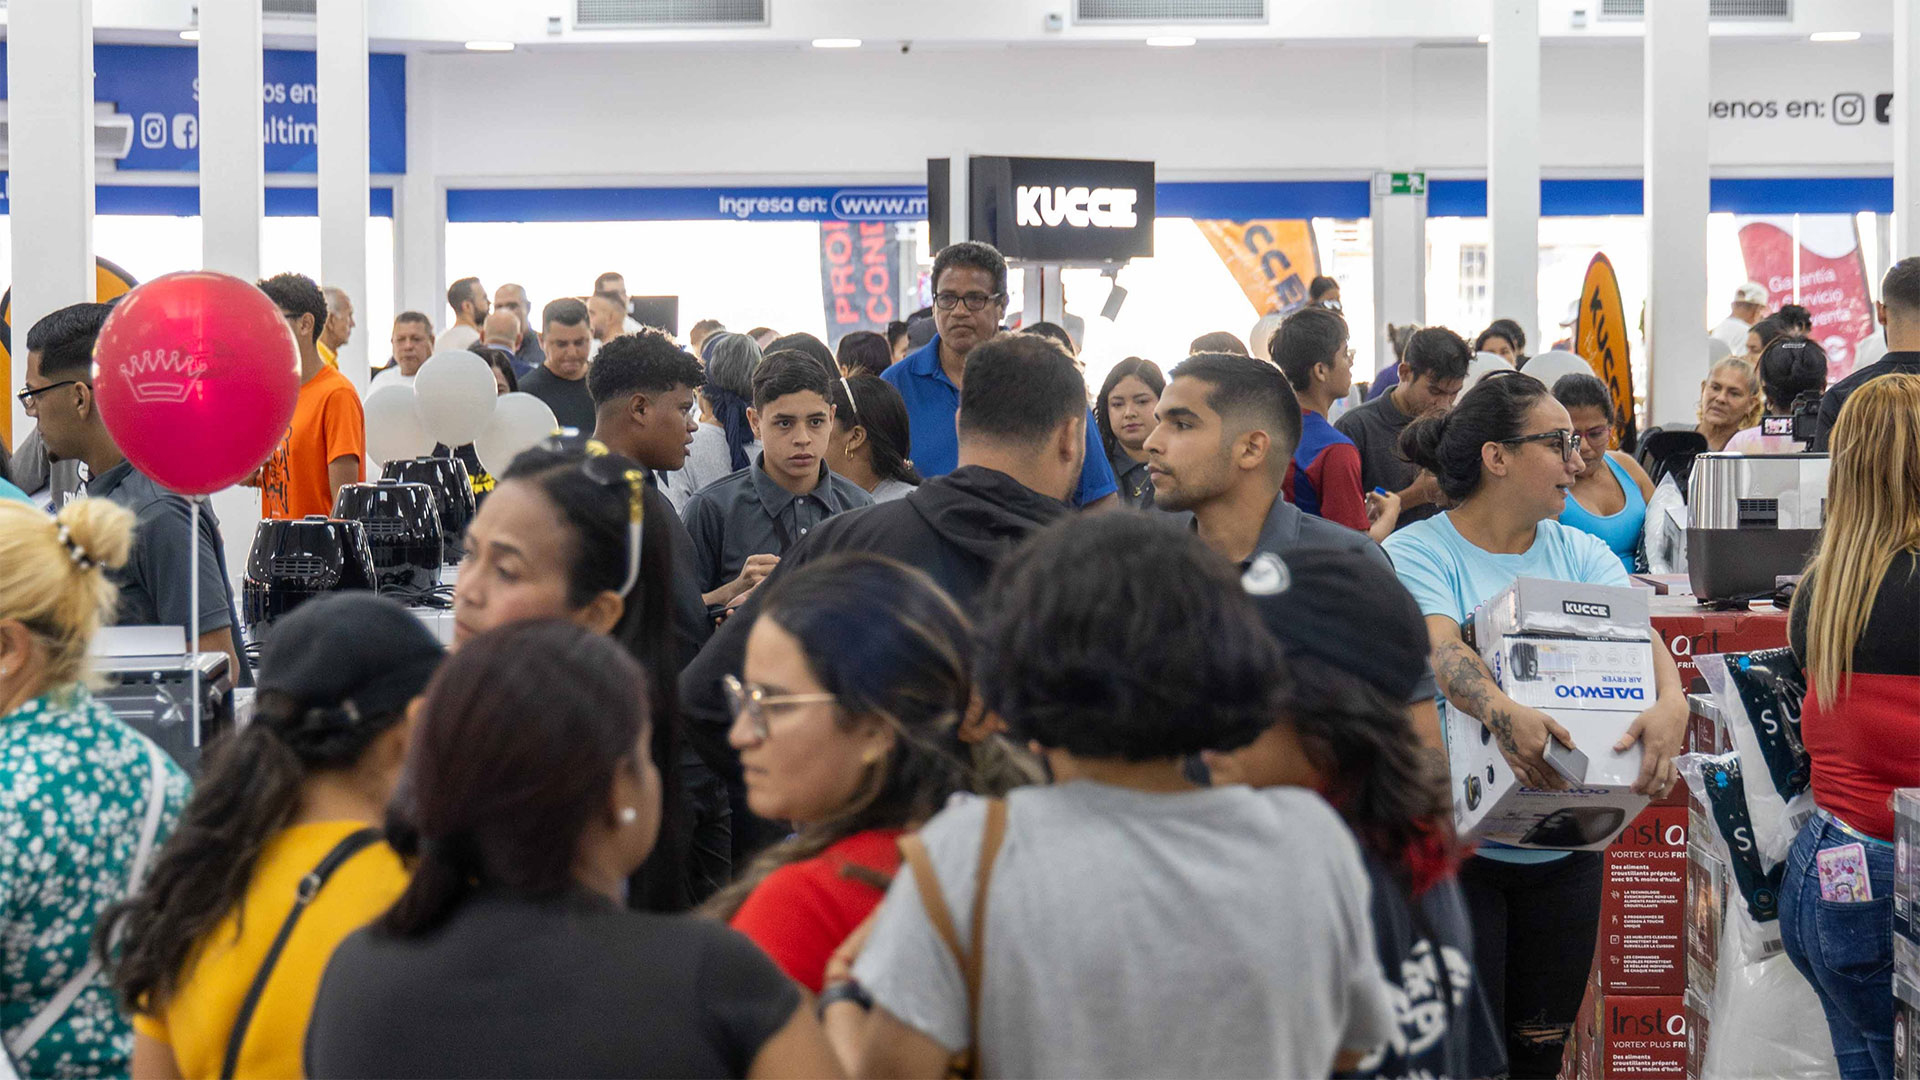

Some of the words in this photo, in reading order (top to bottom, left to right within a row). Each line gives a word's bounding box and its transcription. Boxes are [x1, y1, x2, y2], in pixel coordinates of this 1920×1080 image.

[1785, 100, 1825, 119] en:
[719, 195, 795, 218] Ingresa
[797, 196, 828, 214] en:
[1016, 185, 1138, 229] KUCCE
[1564, 602, 1609, 617] KUCCE
[1601, 675, 1626, 683] FRYER
[1554, 684, 1645, 700] DAEWOO
[1648, 851, 1670, 859] PLUS
[1612, 1006, 1686, 1036] Insta
